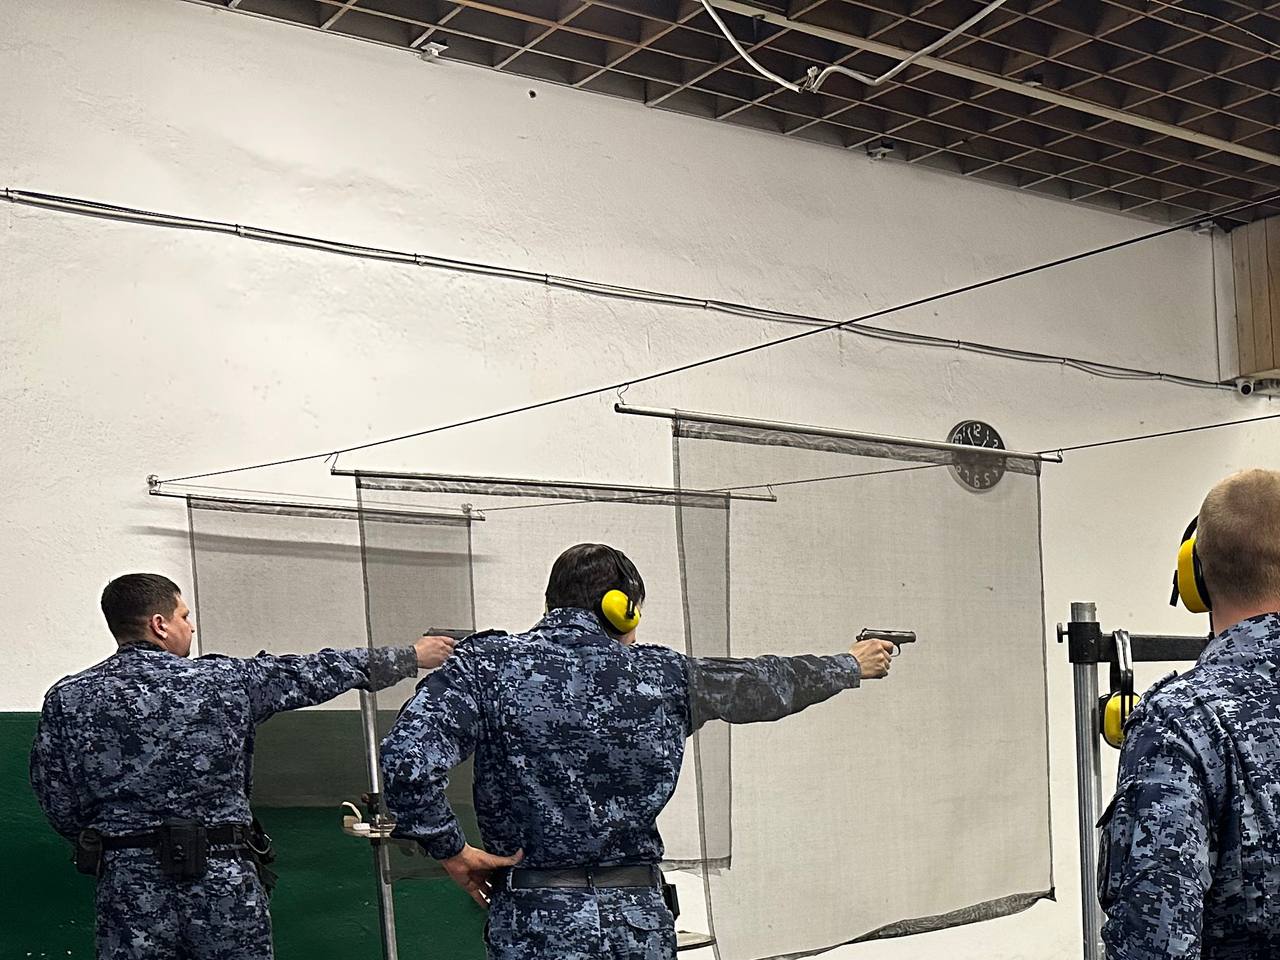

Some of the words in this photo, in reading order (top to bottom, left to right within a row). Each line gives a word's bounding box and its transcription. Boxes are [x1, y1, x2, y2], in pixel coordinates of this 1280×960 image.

[973, 423, 982, 437] 12
[974, 474, 980, 488] 6
[984, 472, 991, 486] 5
